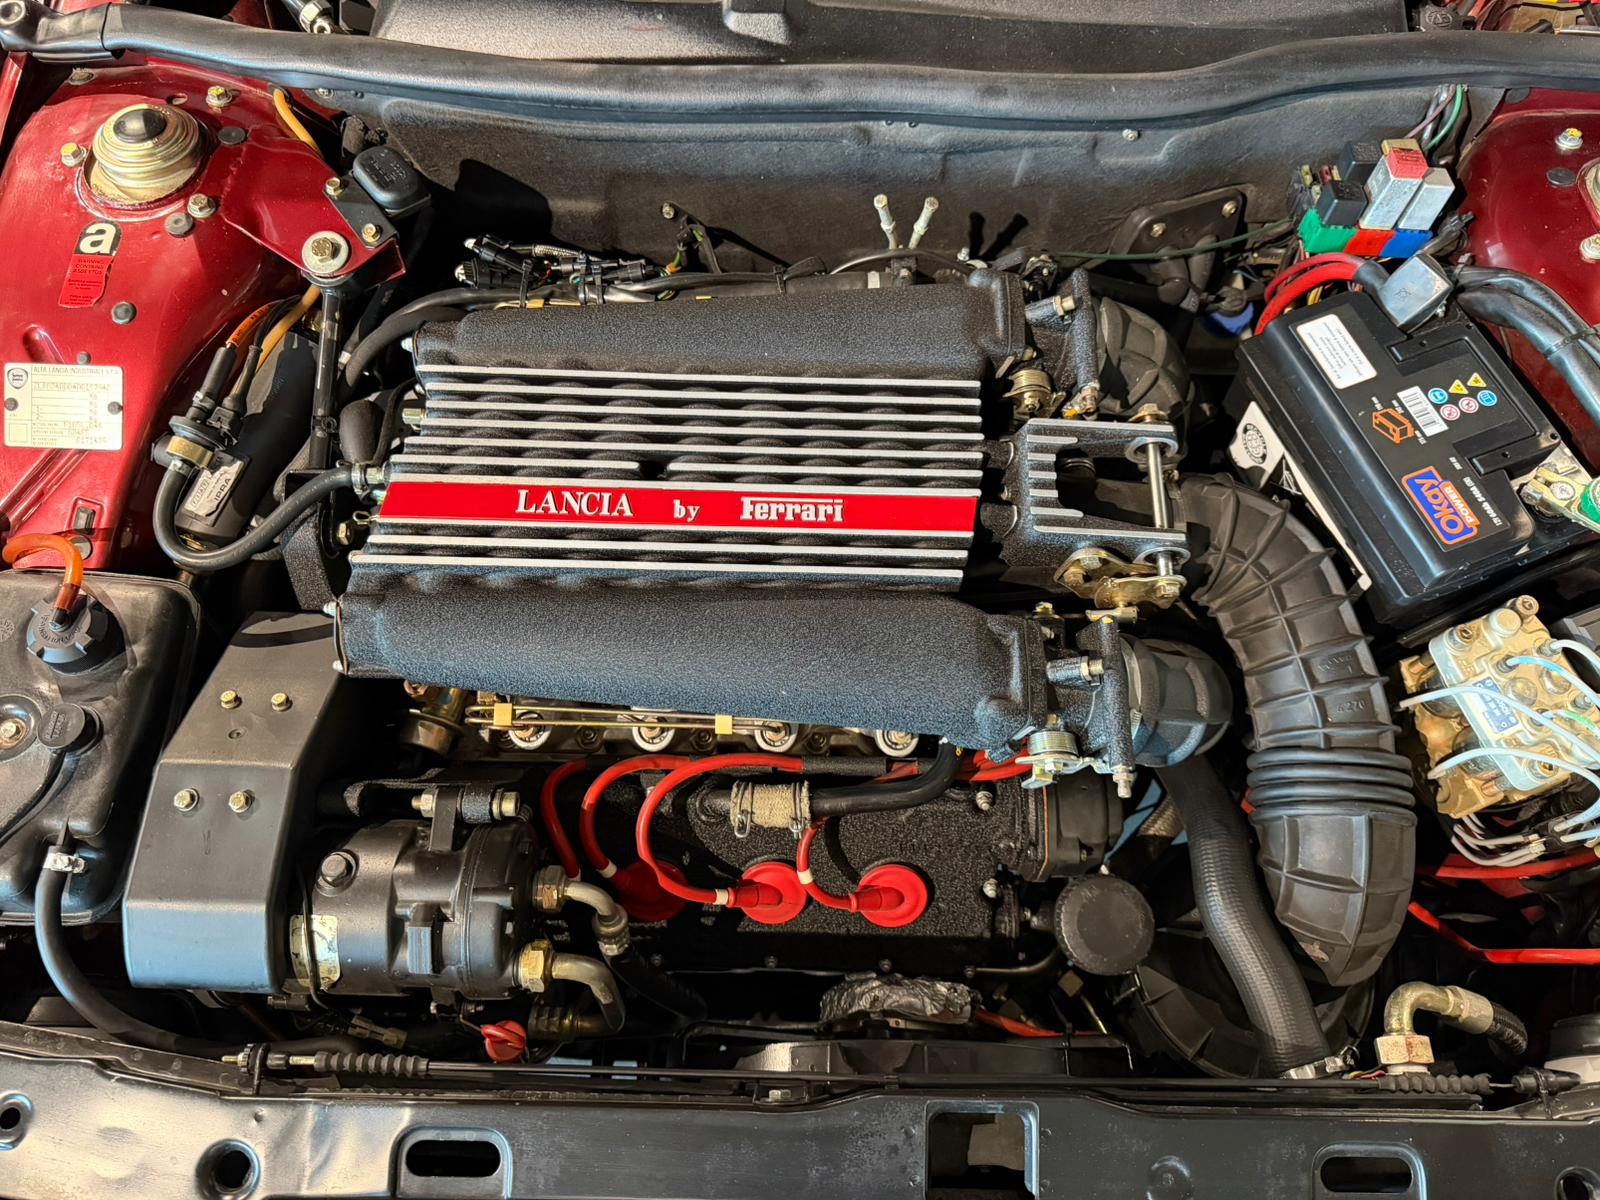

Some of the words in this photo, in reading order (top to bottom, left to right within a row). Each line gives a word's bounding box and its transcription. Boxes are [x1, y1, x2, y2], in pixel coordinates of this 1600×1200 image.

[80, 222, 116, 254] a
[515, 489, 633, 518] LANCIA
[673, 499, 700, 522] by
[740, 496, 844, 522] Ferrari
[1414, 479, 1464, 534] Okay
[1443, 485, 1476, 523] POWER
